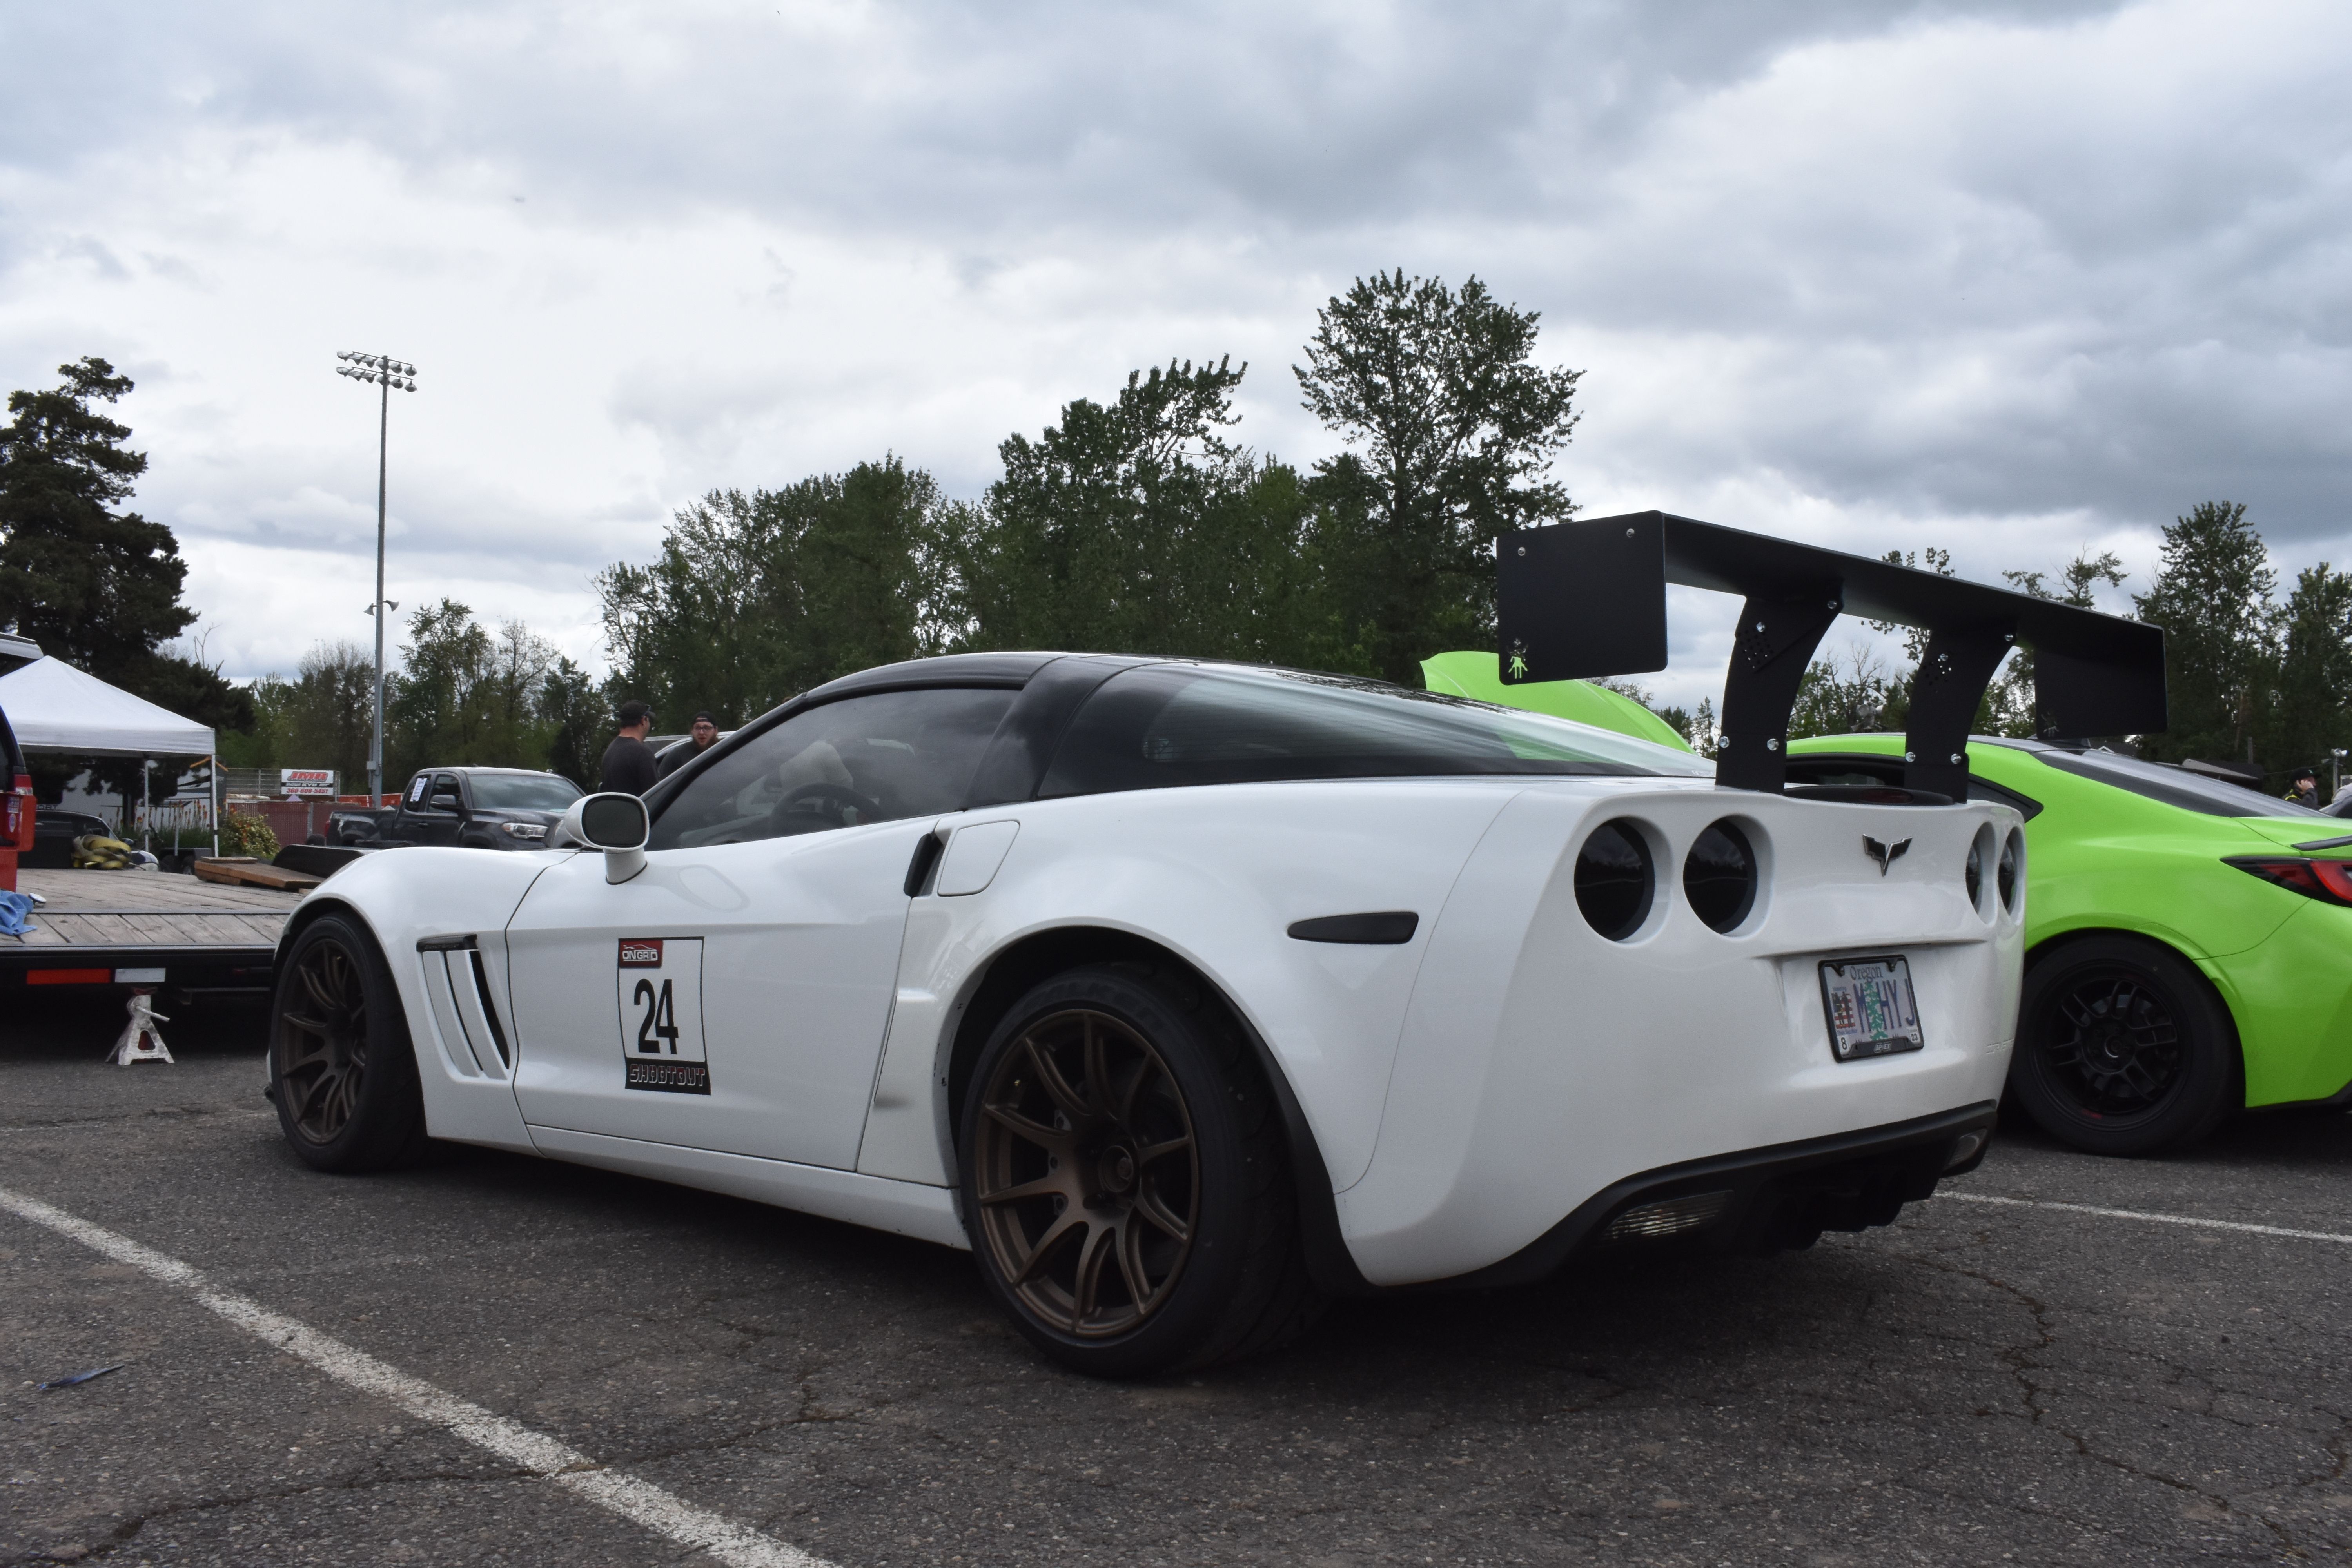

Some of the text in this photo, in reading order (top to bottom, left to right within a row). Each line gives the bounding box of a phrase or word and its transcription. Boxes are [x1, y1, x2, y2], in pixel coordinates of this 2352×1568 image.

[1850, 965, 1883, 983] Oregon
[634, 978, 679, 1054] 24
[1841, 1037, 1847, 1050] 8
[630, 1063, 705, 1087] SHOOTOUT
